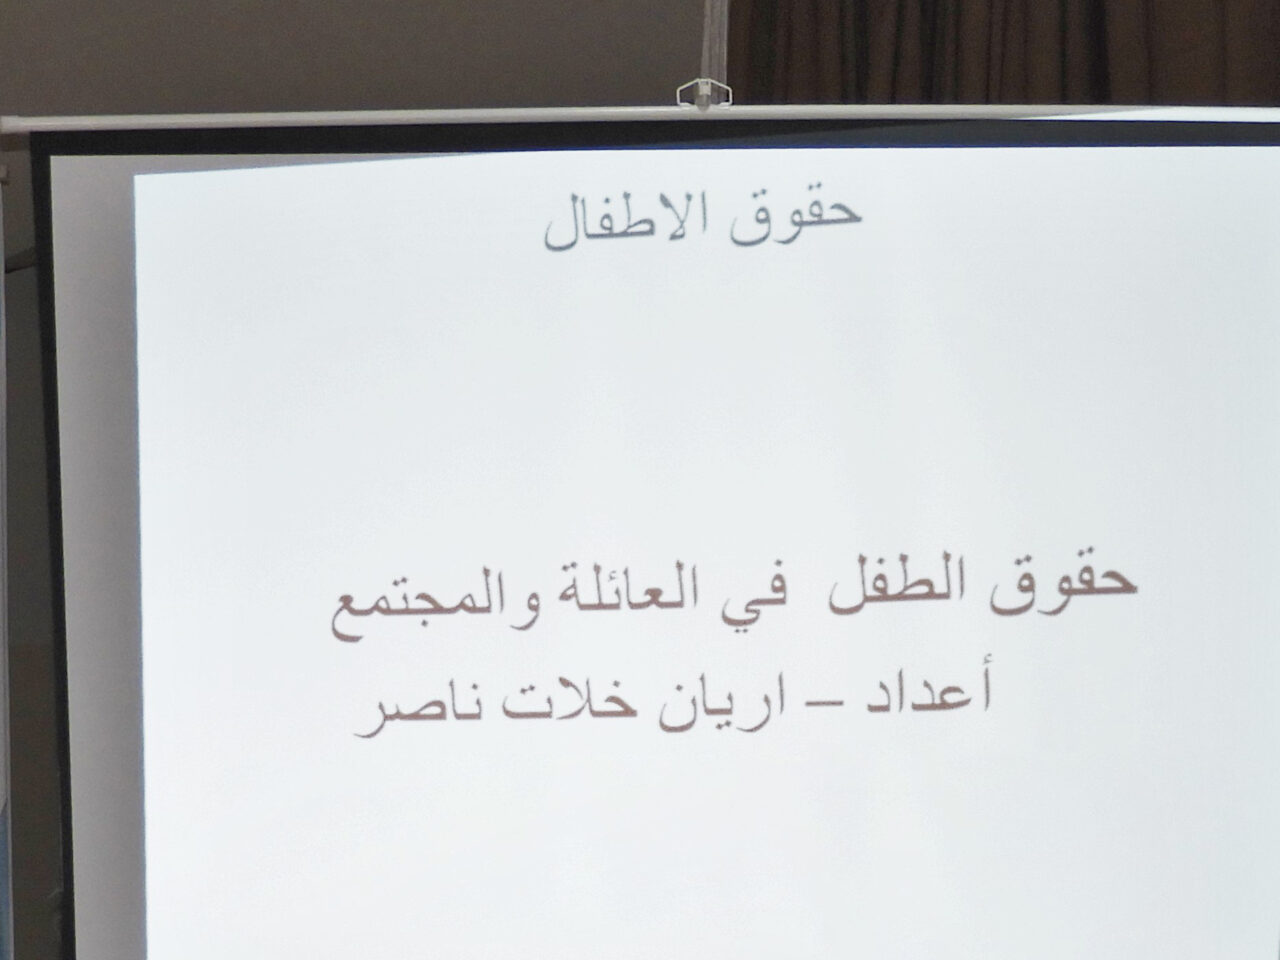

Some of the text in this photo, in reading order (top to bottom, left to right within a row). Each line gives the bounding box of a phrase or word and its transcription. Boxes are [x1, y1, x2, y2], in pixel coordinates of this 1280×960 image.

[545, 182, 862, 252] حقوق الاطفال
[559, 559, 698, 610] العائلة
[722, 559, 787, 633] في
[829, 551, 965, 615] الطفل
[990, 546, 1138, 616] حقوق
[354, 678, 483, 738] ناصر
[866, 653, 993, 713] أعداد
